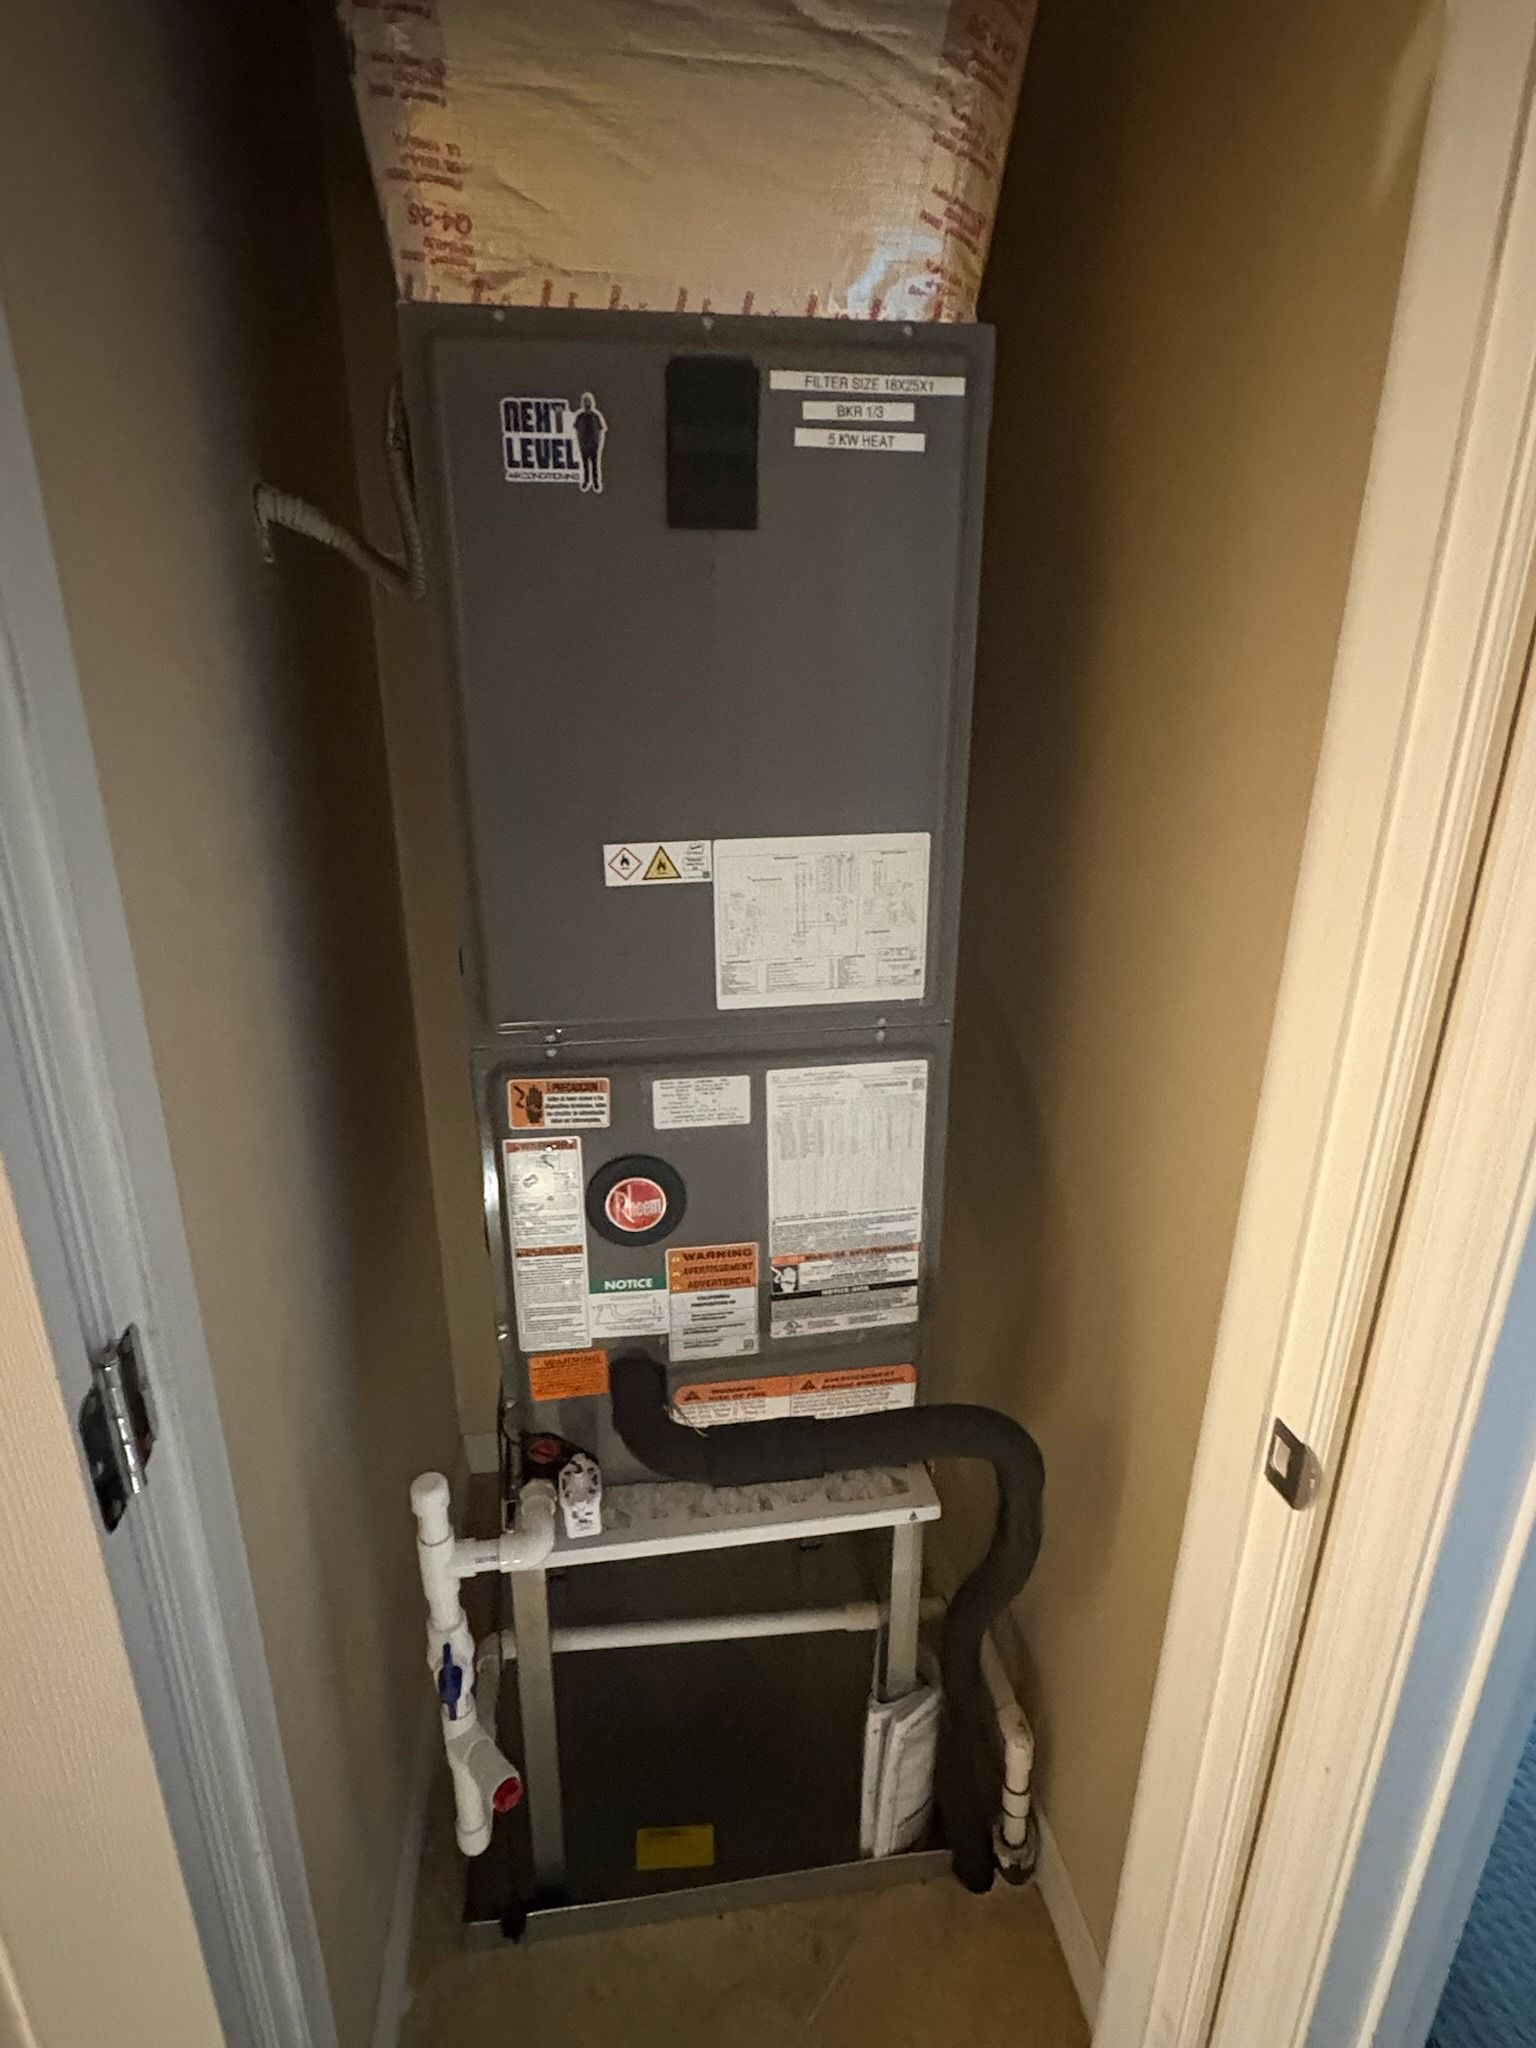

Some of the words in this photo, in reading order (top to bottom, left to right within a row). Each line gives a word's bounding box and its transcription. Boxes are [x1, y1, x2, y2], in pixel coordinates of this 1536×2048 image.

[804, 375, 849, 390] FILTER
[851, 378, 880, 391] SIZE
[884, 379, 935, 392] 18X25X1
[836, 406, 863, 418] BKR
[866, 406, 884, 419] 1/3
[827, 432, 836, 445] 5
[838, 433, 859, 446] KW
[861, 435, 896, 448] HEAT
[505, 437, 581, 469] LEVEL
[614, 1184, 662, 1223] Rheem
[682, 1248, 753, 1261] WARNING
[604, 1278, 653, 1291] NOTICE
